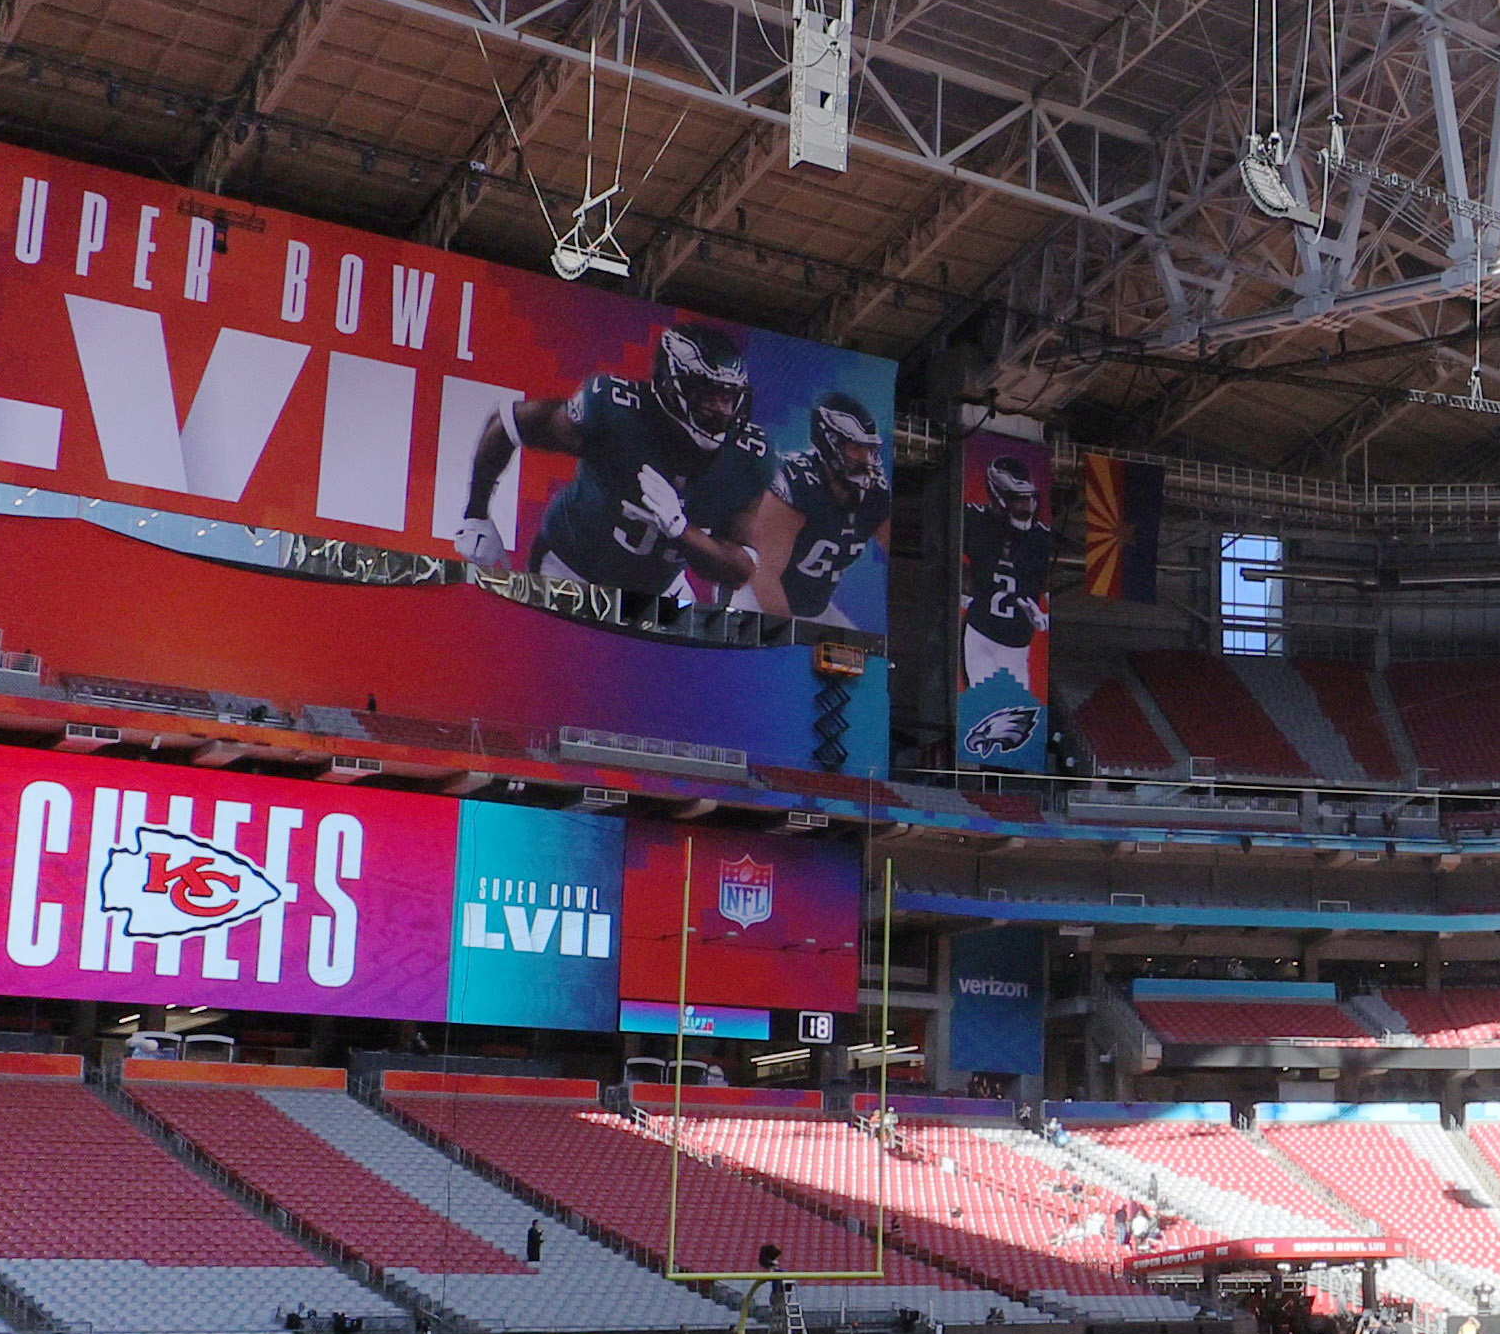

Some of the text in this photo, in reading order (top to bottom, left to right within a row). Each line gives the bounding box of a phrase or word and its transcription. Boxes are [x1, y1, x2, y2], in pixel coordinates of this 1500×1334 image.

[281, 239, 475, 362] BOWL
[989, 571, 1017, 620] 2
[142, 852, 241, 917] KC
[478, 876, 599, 910] SUPER BOWL
[726, 885, 766, 916] NFL
[461, 901, 611, 959] LVII
[958, 975, 1028, 998] verizon
[808, 1015, 829, 1039] 18
